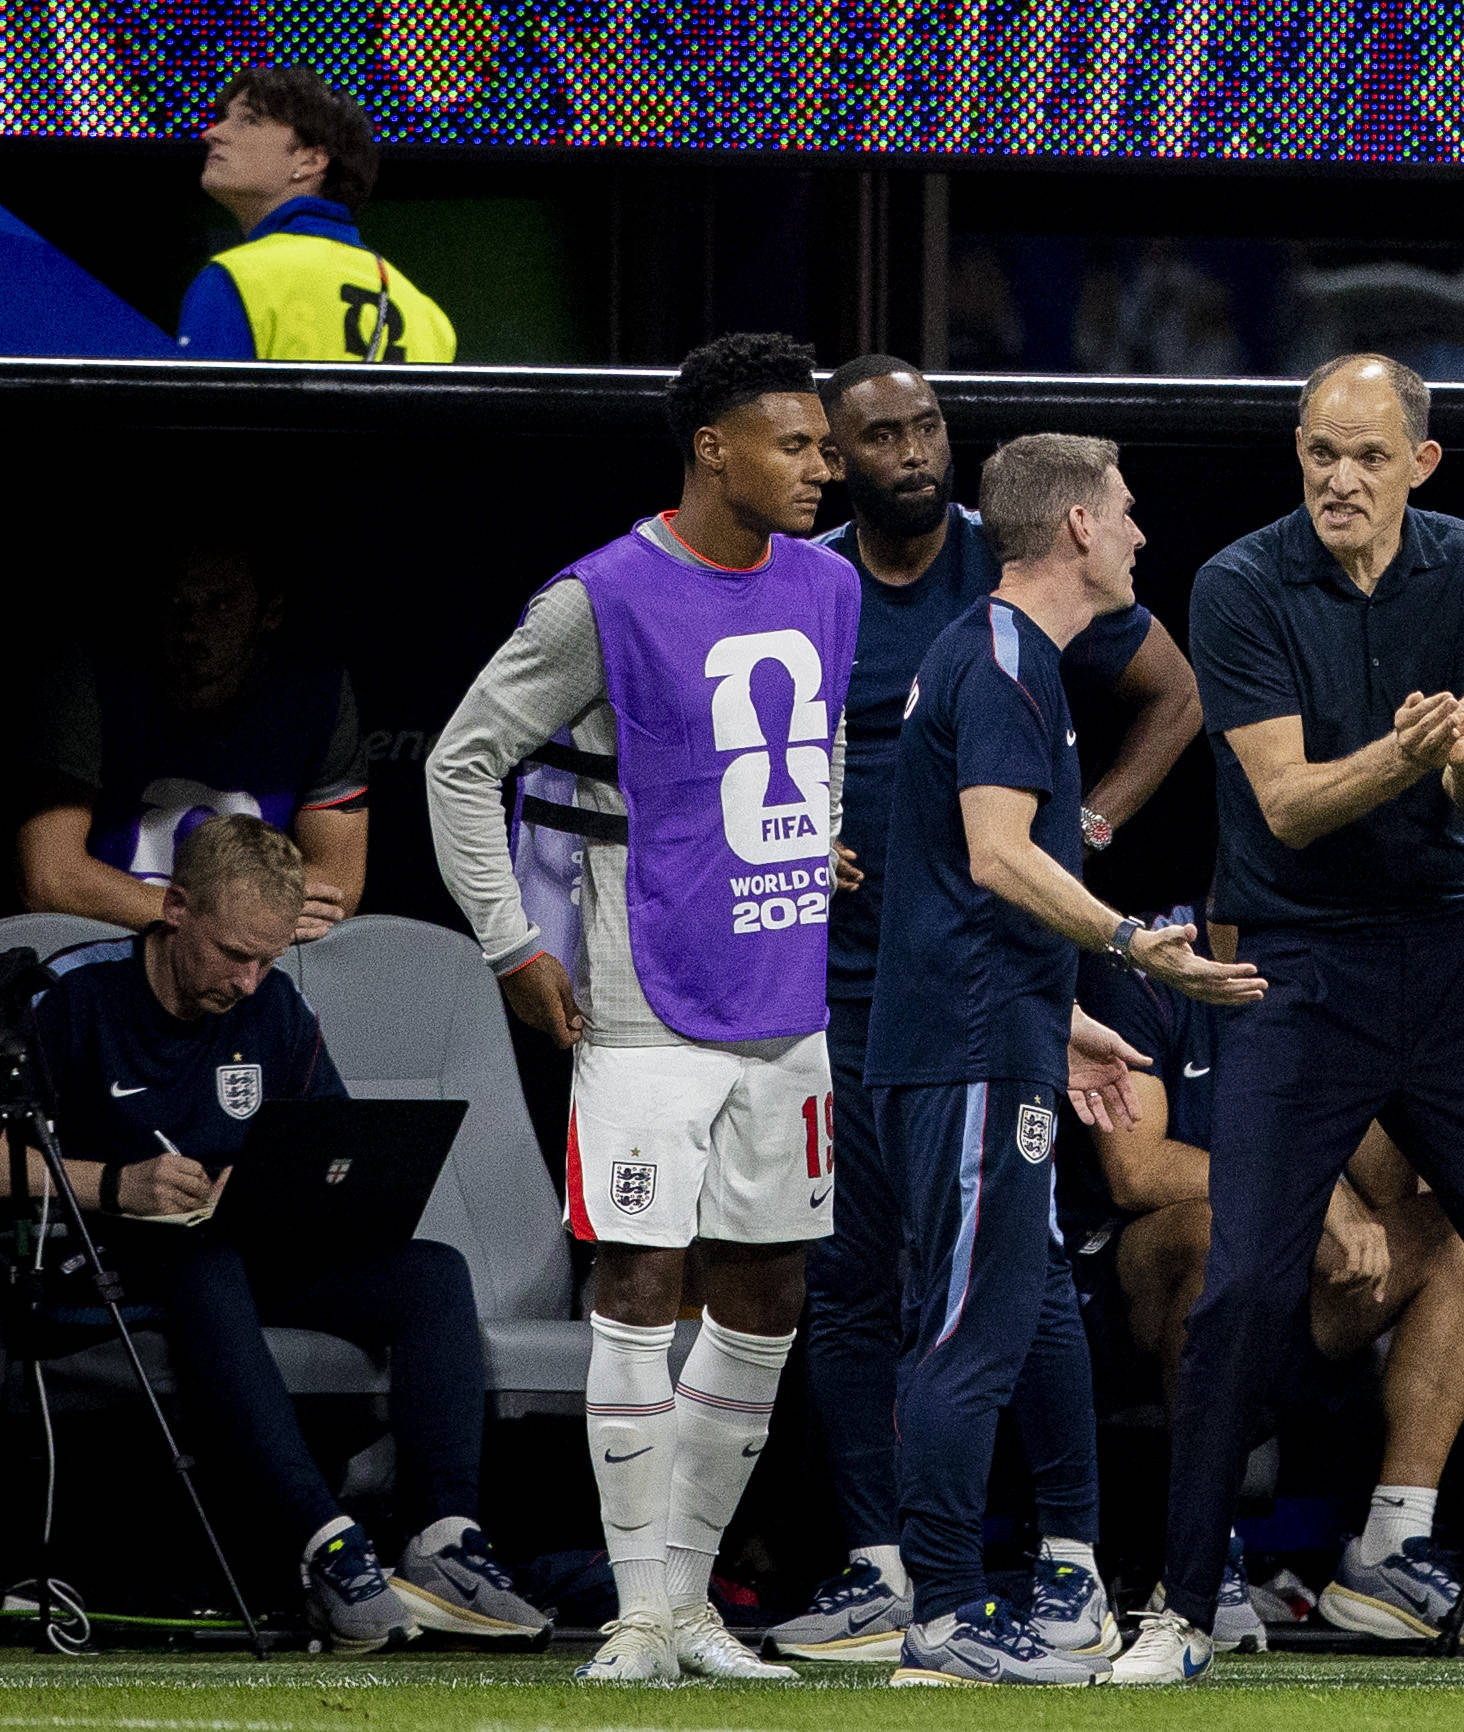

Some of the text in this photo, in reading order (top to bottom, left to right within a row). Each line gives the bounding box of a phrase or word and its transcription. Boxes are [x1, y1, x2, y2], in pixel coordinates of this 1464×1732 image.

[762, 814, 817, 842] FIFA
[730, 870, 810, 897] WORLD
[732, 892, 829, 934] 202
